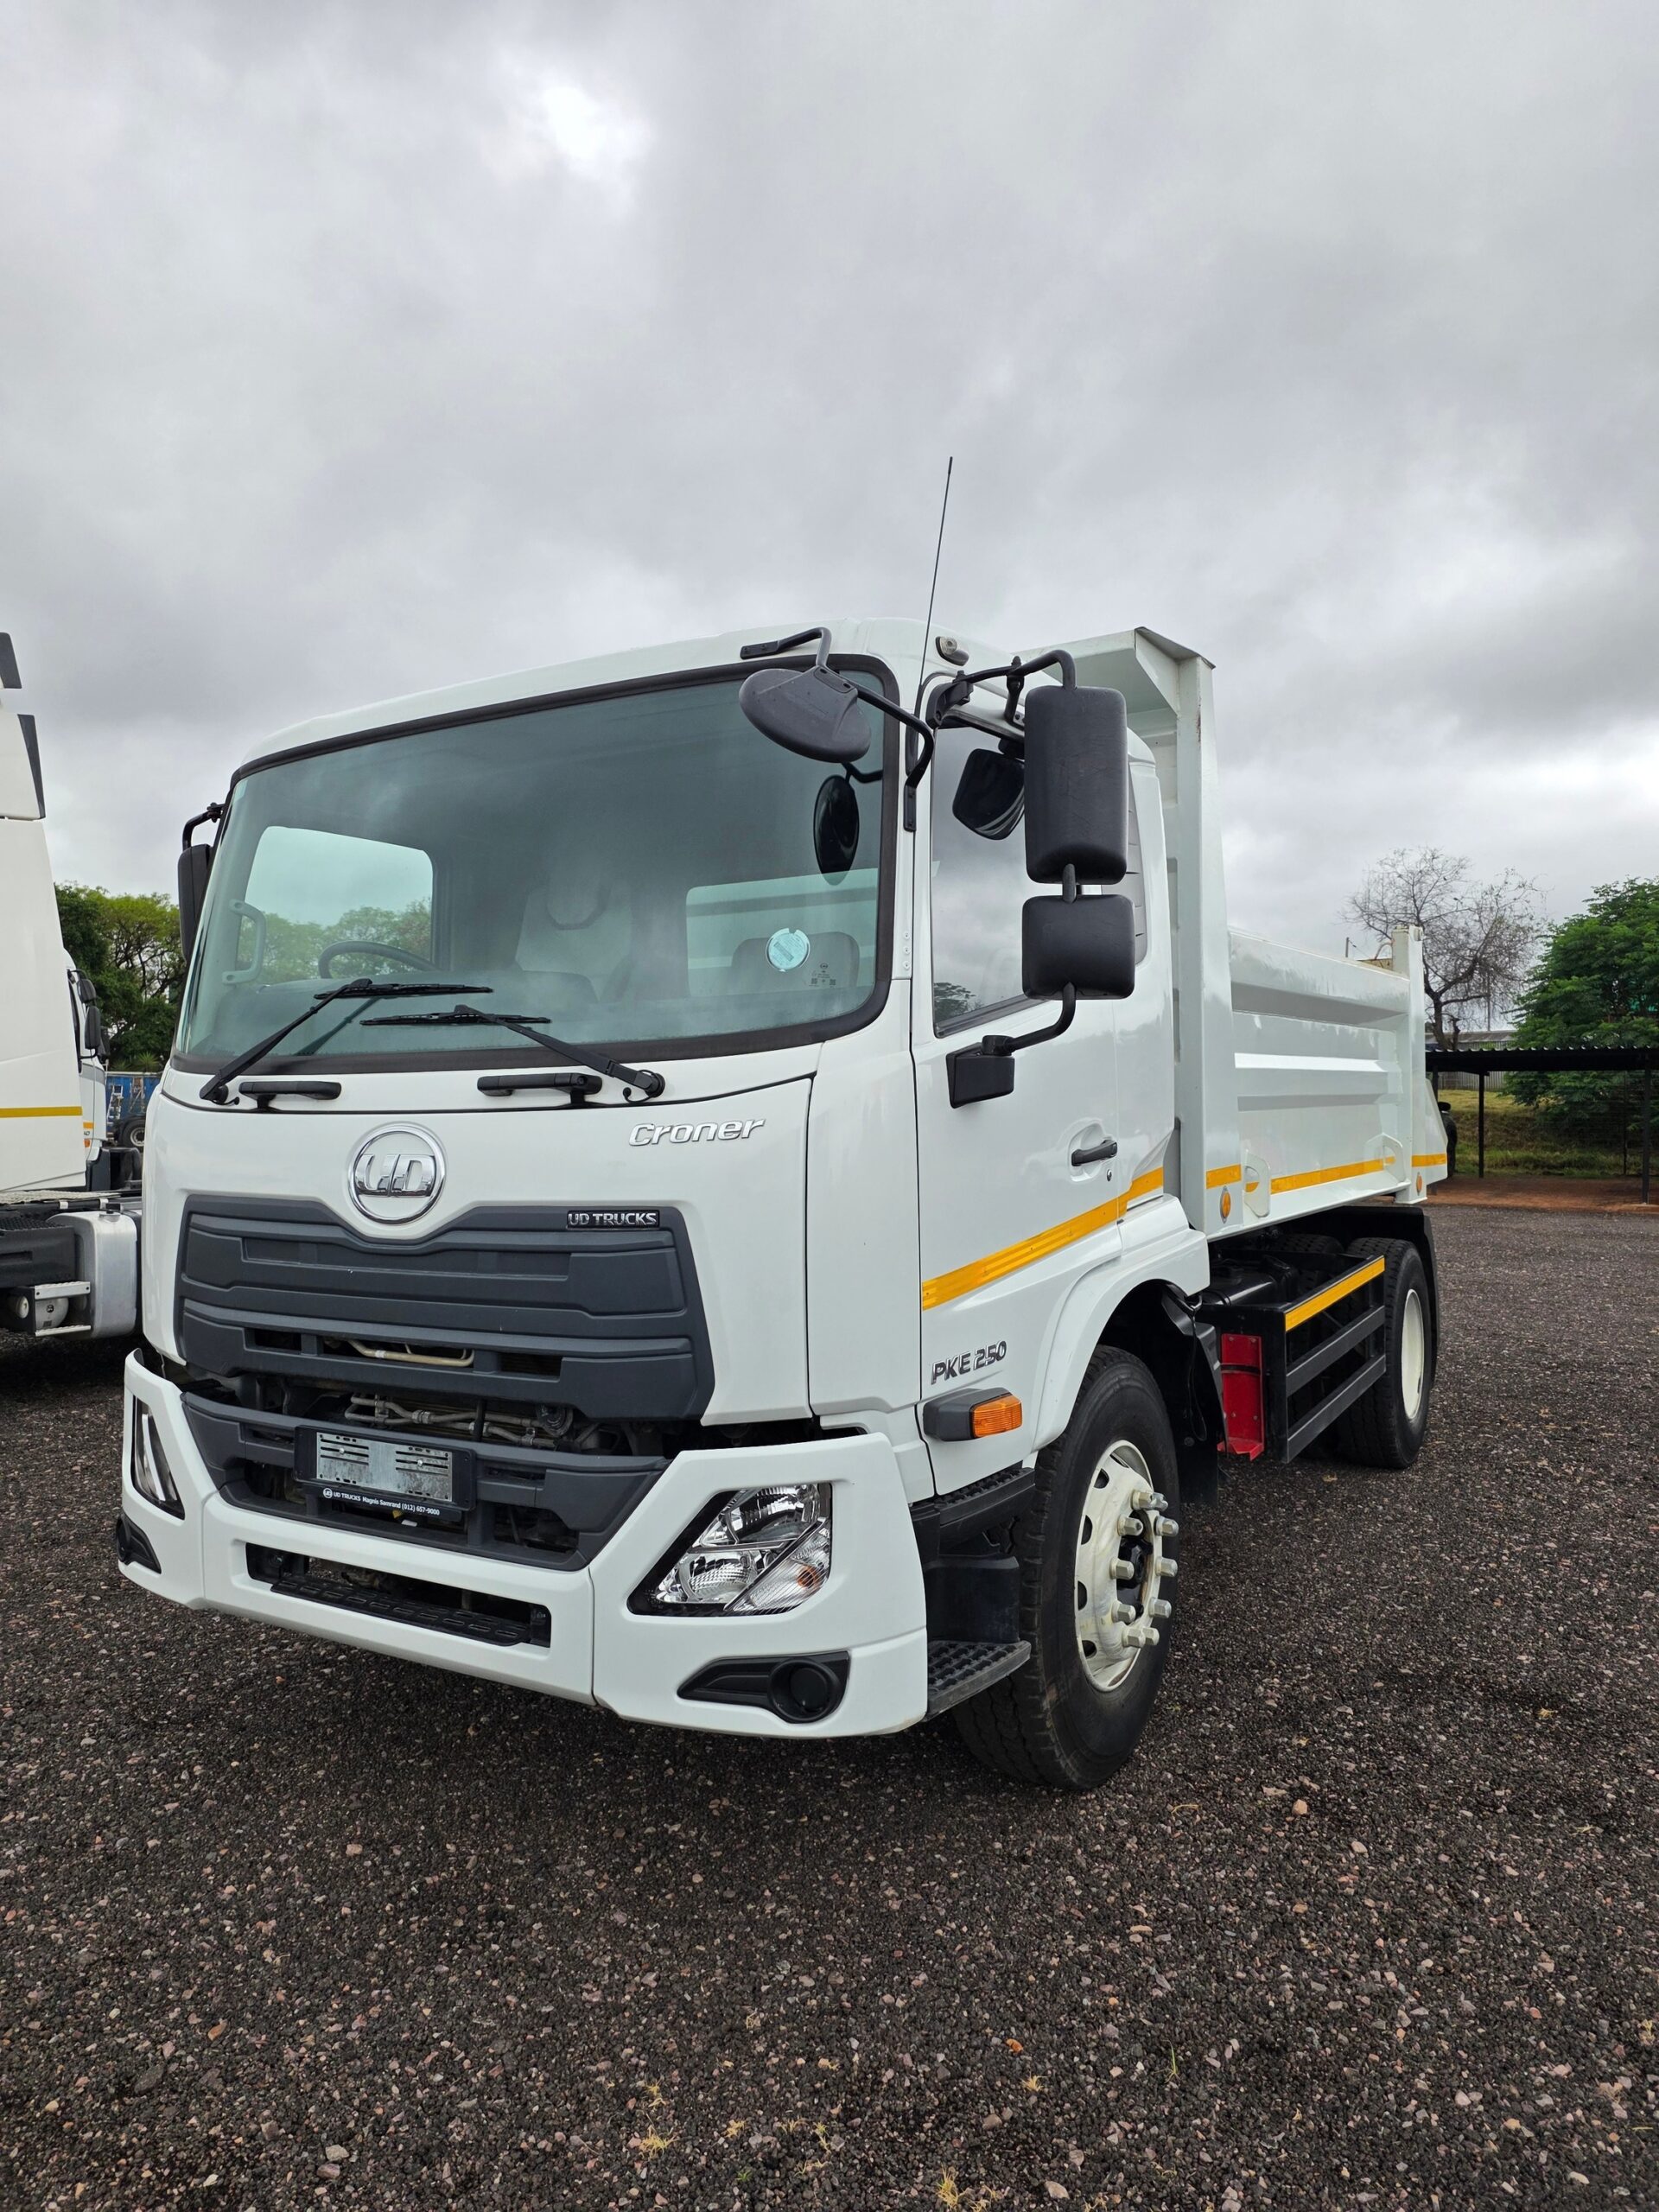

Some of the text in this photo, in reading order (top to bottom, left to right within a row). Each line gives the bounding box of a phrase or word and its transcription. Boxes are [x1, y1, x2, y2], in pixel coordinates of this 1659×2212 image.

[629, 1119, 766, 1147] Croner
[355, 1154, 435, 1198] UD
[568, 1212, 657, 1225] UD TRUCKS
[931, 1340, 1007, 1385] PKE 250
[341, 1492, 361, 1502] TRUCKS
[402, 1503, 416, 1512] (012)
